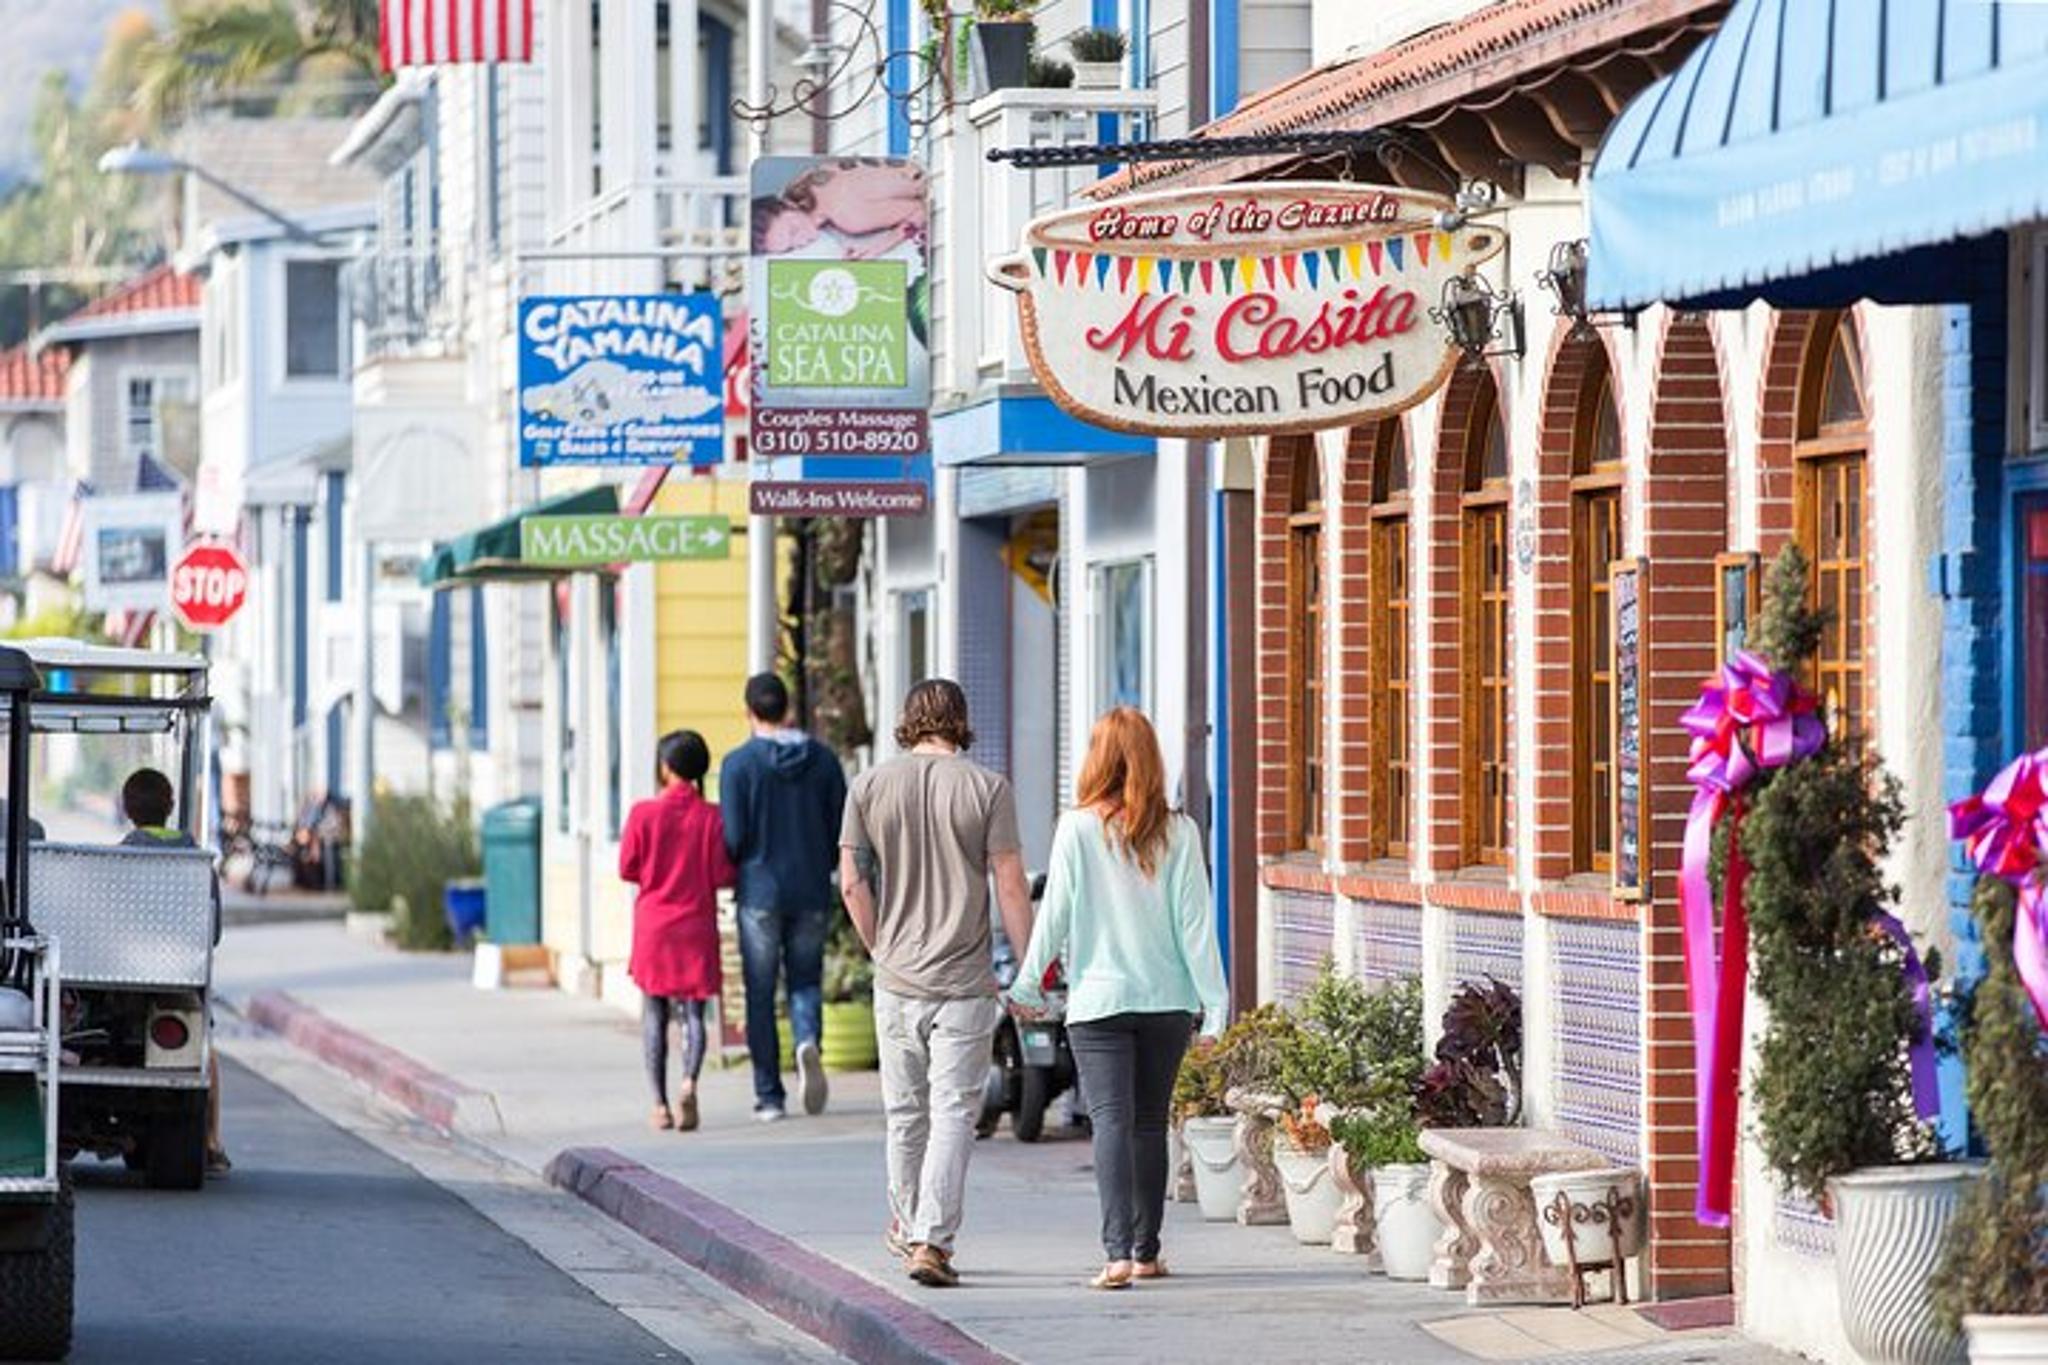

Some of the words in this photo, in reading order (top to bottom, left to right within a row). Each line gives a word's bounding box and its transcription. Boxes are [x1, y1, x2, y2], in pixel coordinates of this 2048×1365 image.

[1090, 207, 1178, 241] Home
[1187, 199, 1224, 240] of
[1227, 199, 1271, 233] the
[1277, 191, 1398, 230] Cazuela
[525, 299, 714, 349] CATALINA
[778, 324, 895, 342] CATALINA
[1086, 292, 1195, 362] Mi
[1216, 285, 1418, 363] Casita
[534, 329, 704, 376] YAMAHA
[778, 345, 831, 382] SEA
[841, 345, 895, 382] SPA
[1114, 367, 1279, 415] Mexican
[1297, 351, 1395, 408] Food
[758, 410, 833, 431] Couples
[838, 411, 917, 431] Massage
[756, 431, 811, 451] (310)
[816, 431, 919, 450] 510-8920
[757, 490, 834, 507] Walk-Ins
[838, 490, 922, 508] Welcome
[531, 521, 696, 556] MASSAGE
[175, 566, 245, 607] STOP
